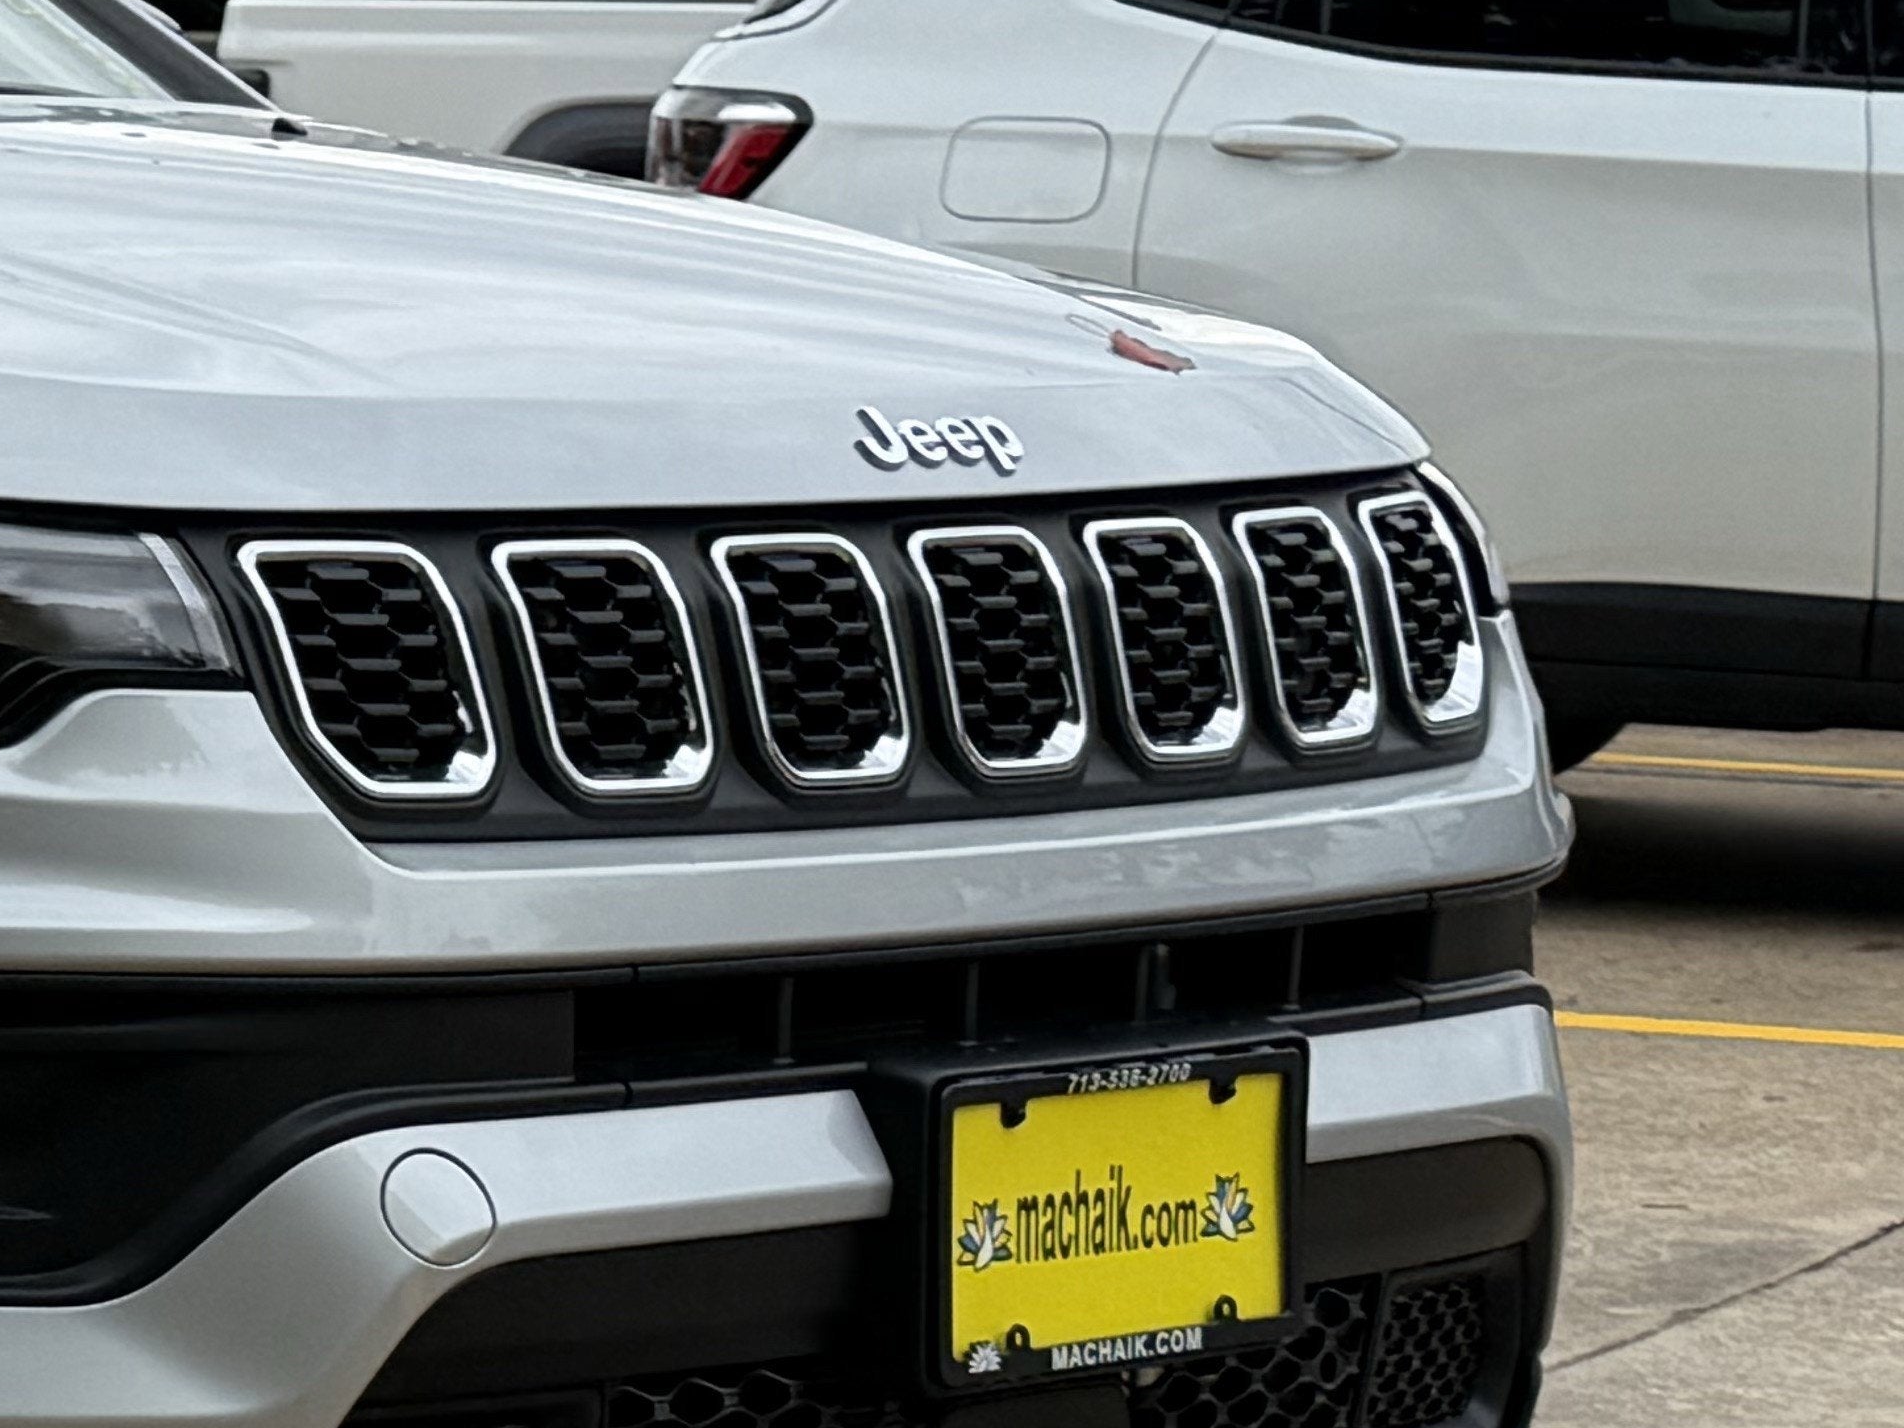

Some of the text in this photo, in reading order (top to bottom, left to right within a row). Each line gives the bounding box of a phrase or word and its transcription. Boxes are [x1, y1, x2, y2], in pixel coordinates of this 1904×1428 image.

[853, 406, 1024, 477] Jeep
[1016, 1165, 1198, 1264] machaik.com
[1052, 1326, 1204, 1371] MACHAIK.COM
